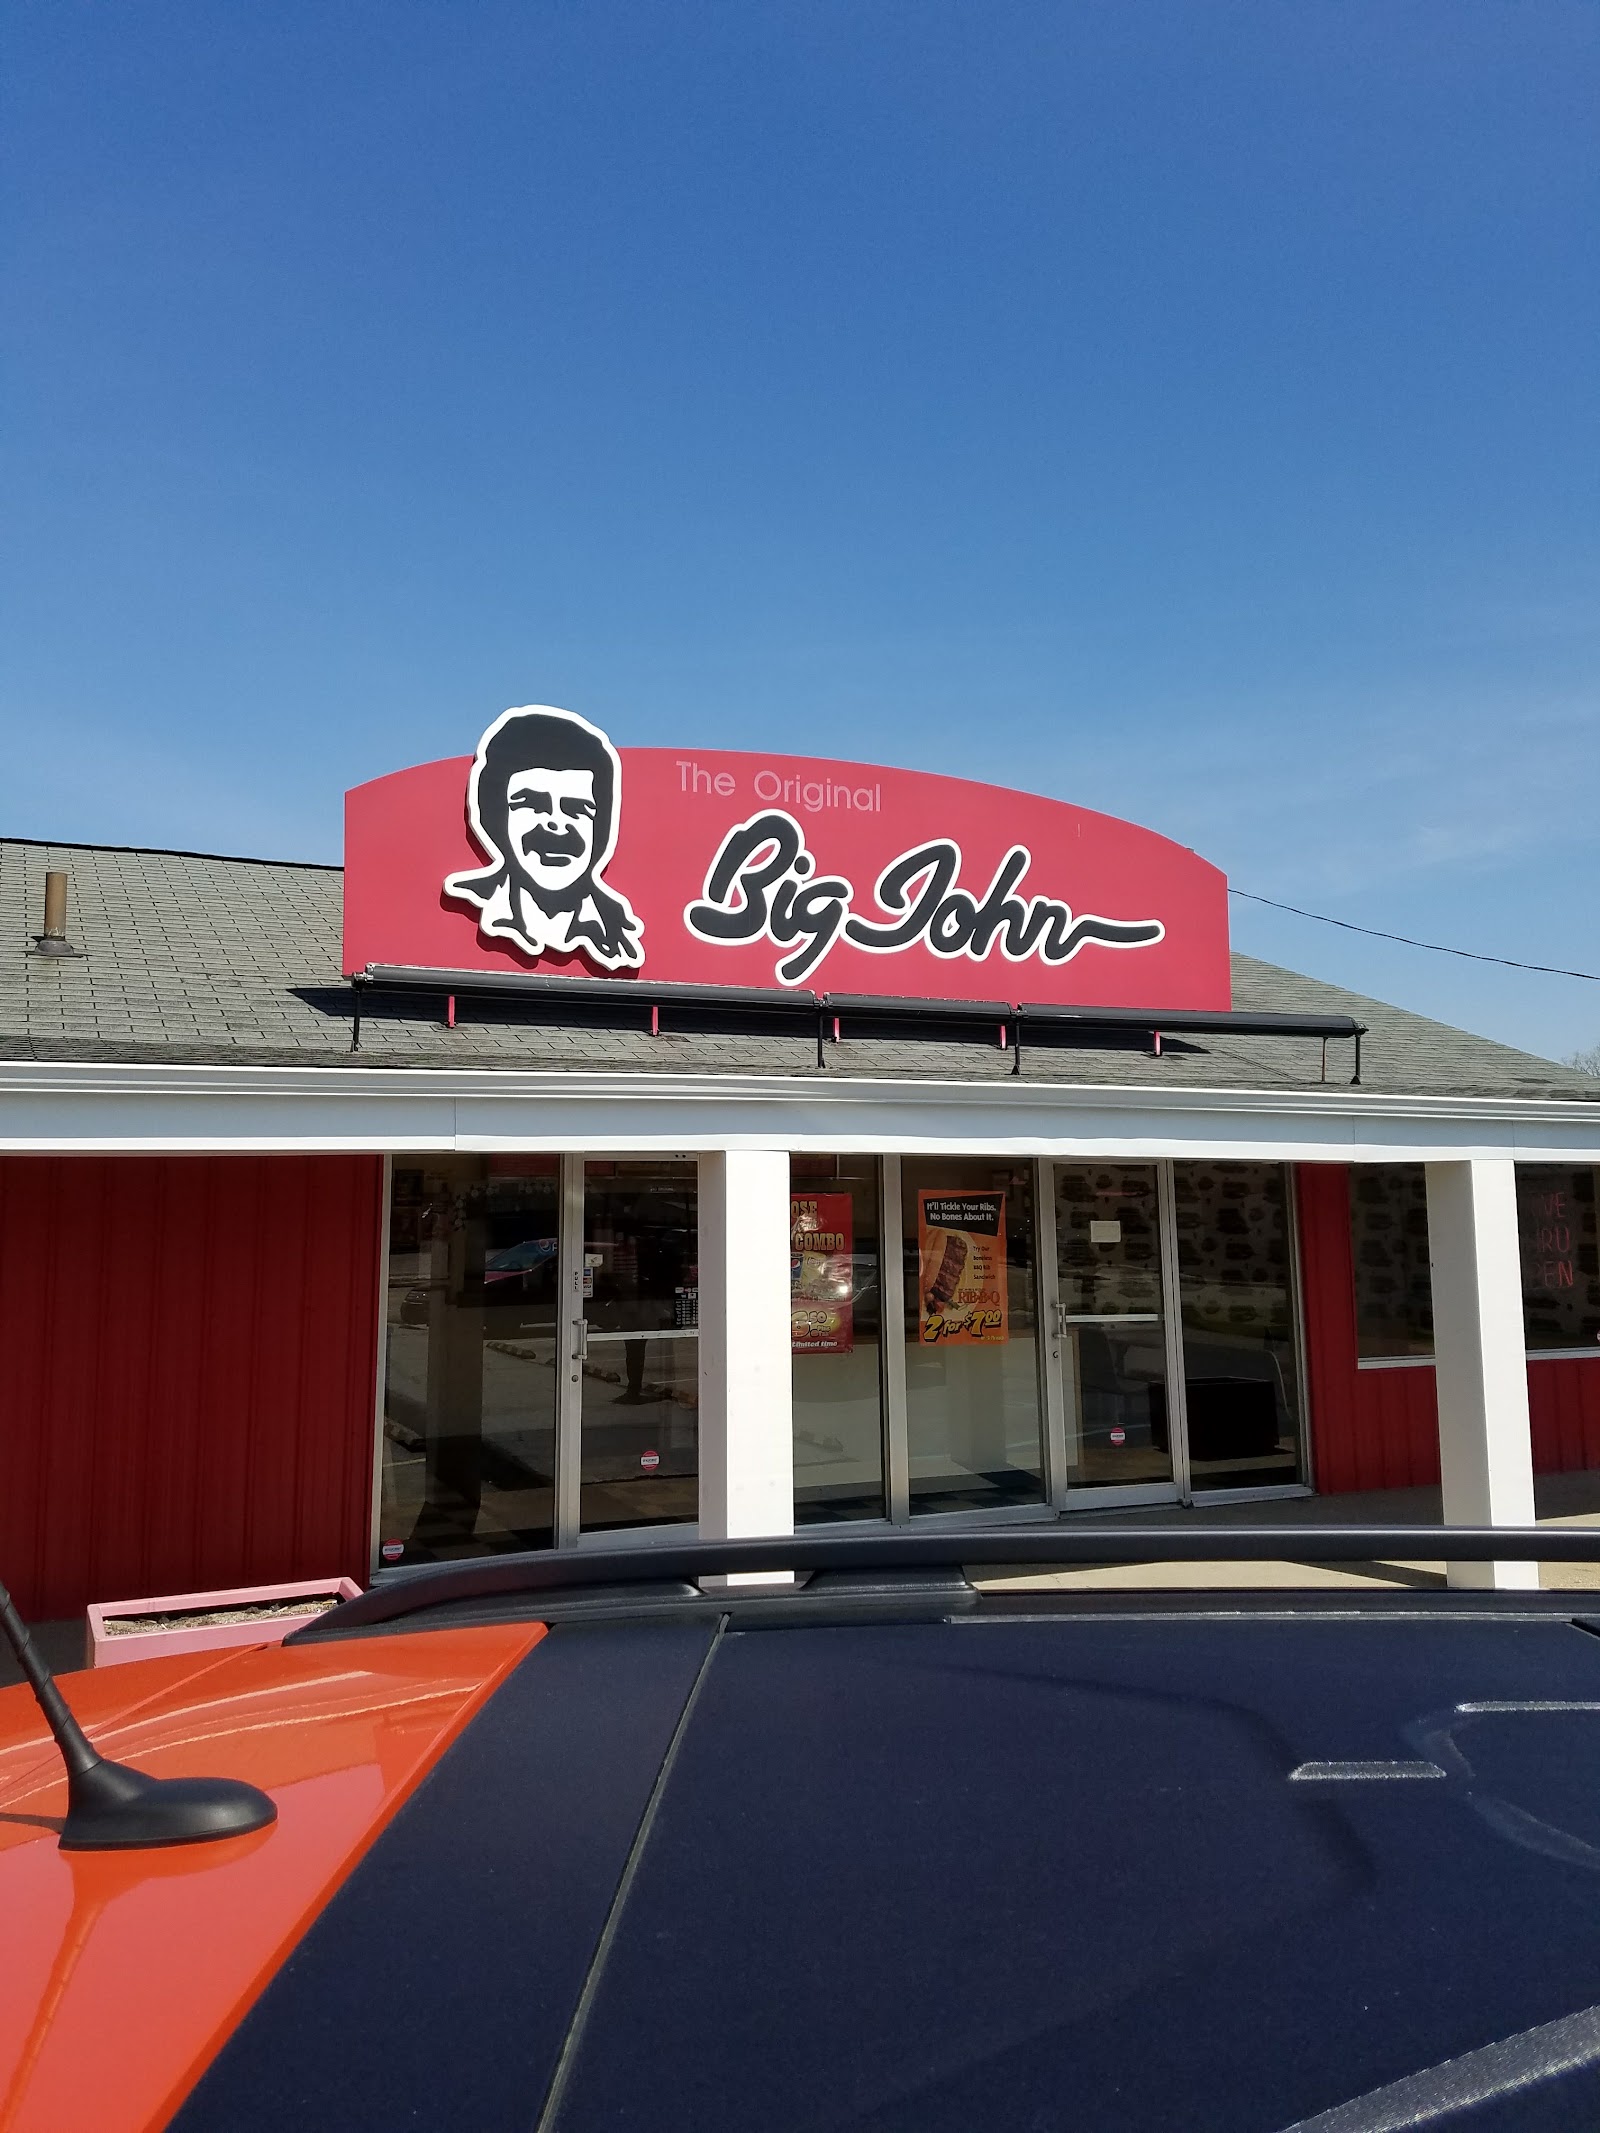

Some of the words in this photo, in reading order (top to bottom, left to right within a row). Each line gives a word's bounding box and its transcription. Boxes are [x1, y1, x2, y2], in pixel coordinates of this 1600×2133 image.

[676, 760, 736, 797] The
[754, 770, 881, 812] Original
[683, 809, 854, 986] Big
[844, 838, 1165, 966] John
[791, 1200, 818, 1219] OSE
[926, 1201, 939, 1210] It'll
[939, 1201, 961, 1211] Tickle
[961, 1202, 979, 1211] Your
[979, 1203, 997, 1212] Ribs.
[930, 1212, 941, 1221] No
[941, 1212, 963, 1222] Bones
[963, 1212, 985, 1222] About
[985, 1213, 995, 1222] It.
[795, 1232, 845, 1251] COMBO
[923, 1314, 943, 1342] 2
[942, 1319, 962, 1337] for
[820, 1340, 838, 1348] time
